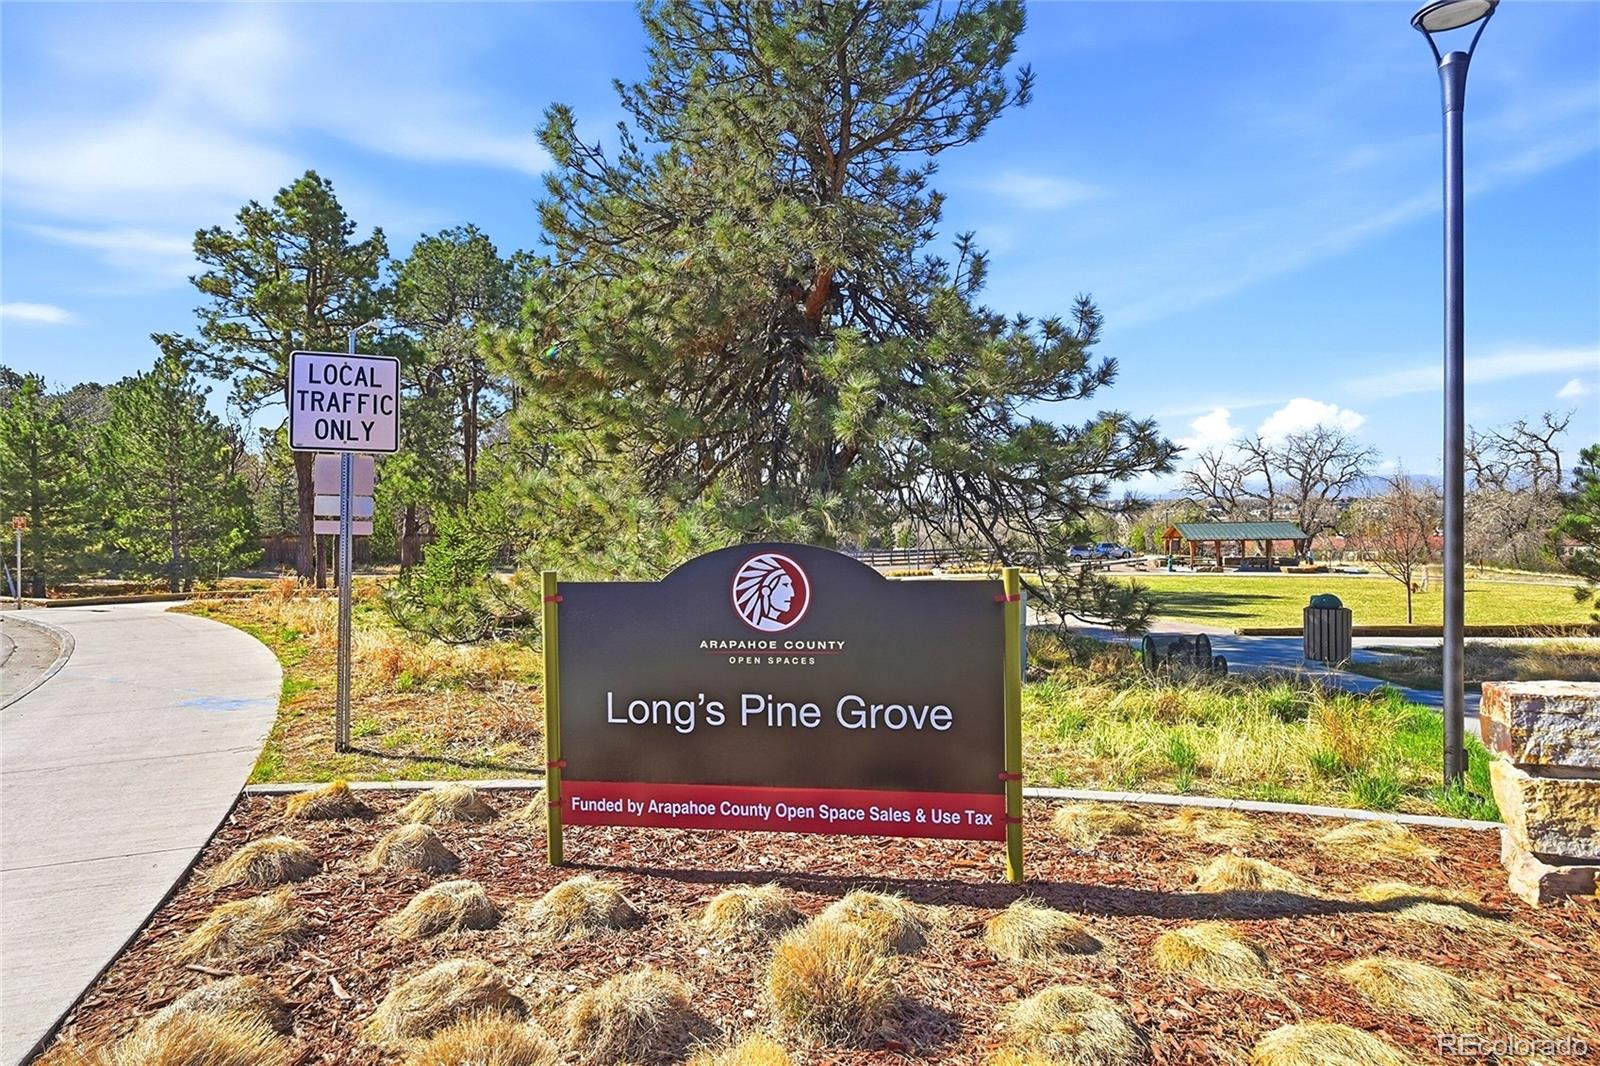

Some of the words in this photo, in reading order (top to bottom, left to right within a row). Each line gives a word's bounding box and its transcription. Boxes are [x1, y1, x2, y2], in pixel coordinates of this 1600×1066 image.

[309, 363, 382, 388] LOCAL
[297, 390, 393, 416] TRAFFIC
[315, 418, 375, 441] ONLY
[700, 640, 777, 650] ARAPAHOE
[784, 640, 846, 650] COUNTY
[729, 656, 761, 665] OPEN
[768, 656, 816, 665] SPACES
[606, 691, 726, 733] Long’s
[741, 693, 821, 728] Pine
[836, 695, 953, 731] Grove
[571, 797, 623, 812] Funded
[627, 800, 644, 816] by
[648, 800, 716, 819] Arapahoe
[720, 802, 772, 821] County
[775, 803, 815, 822] Open
[819, 805, 866, 824] Space
[870, 807, 912, 823] Sales
[915, 809, 926, 824] &
[931, 809, 960, 824] Use
[965, 810, 993, 826] Tax
